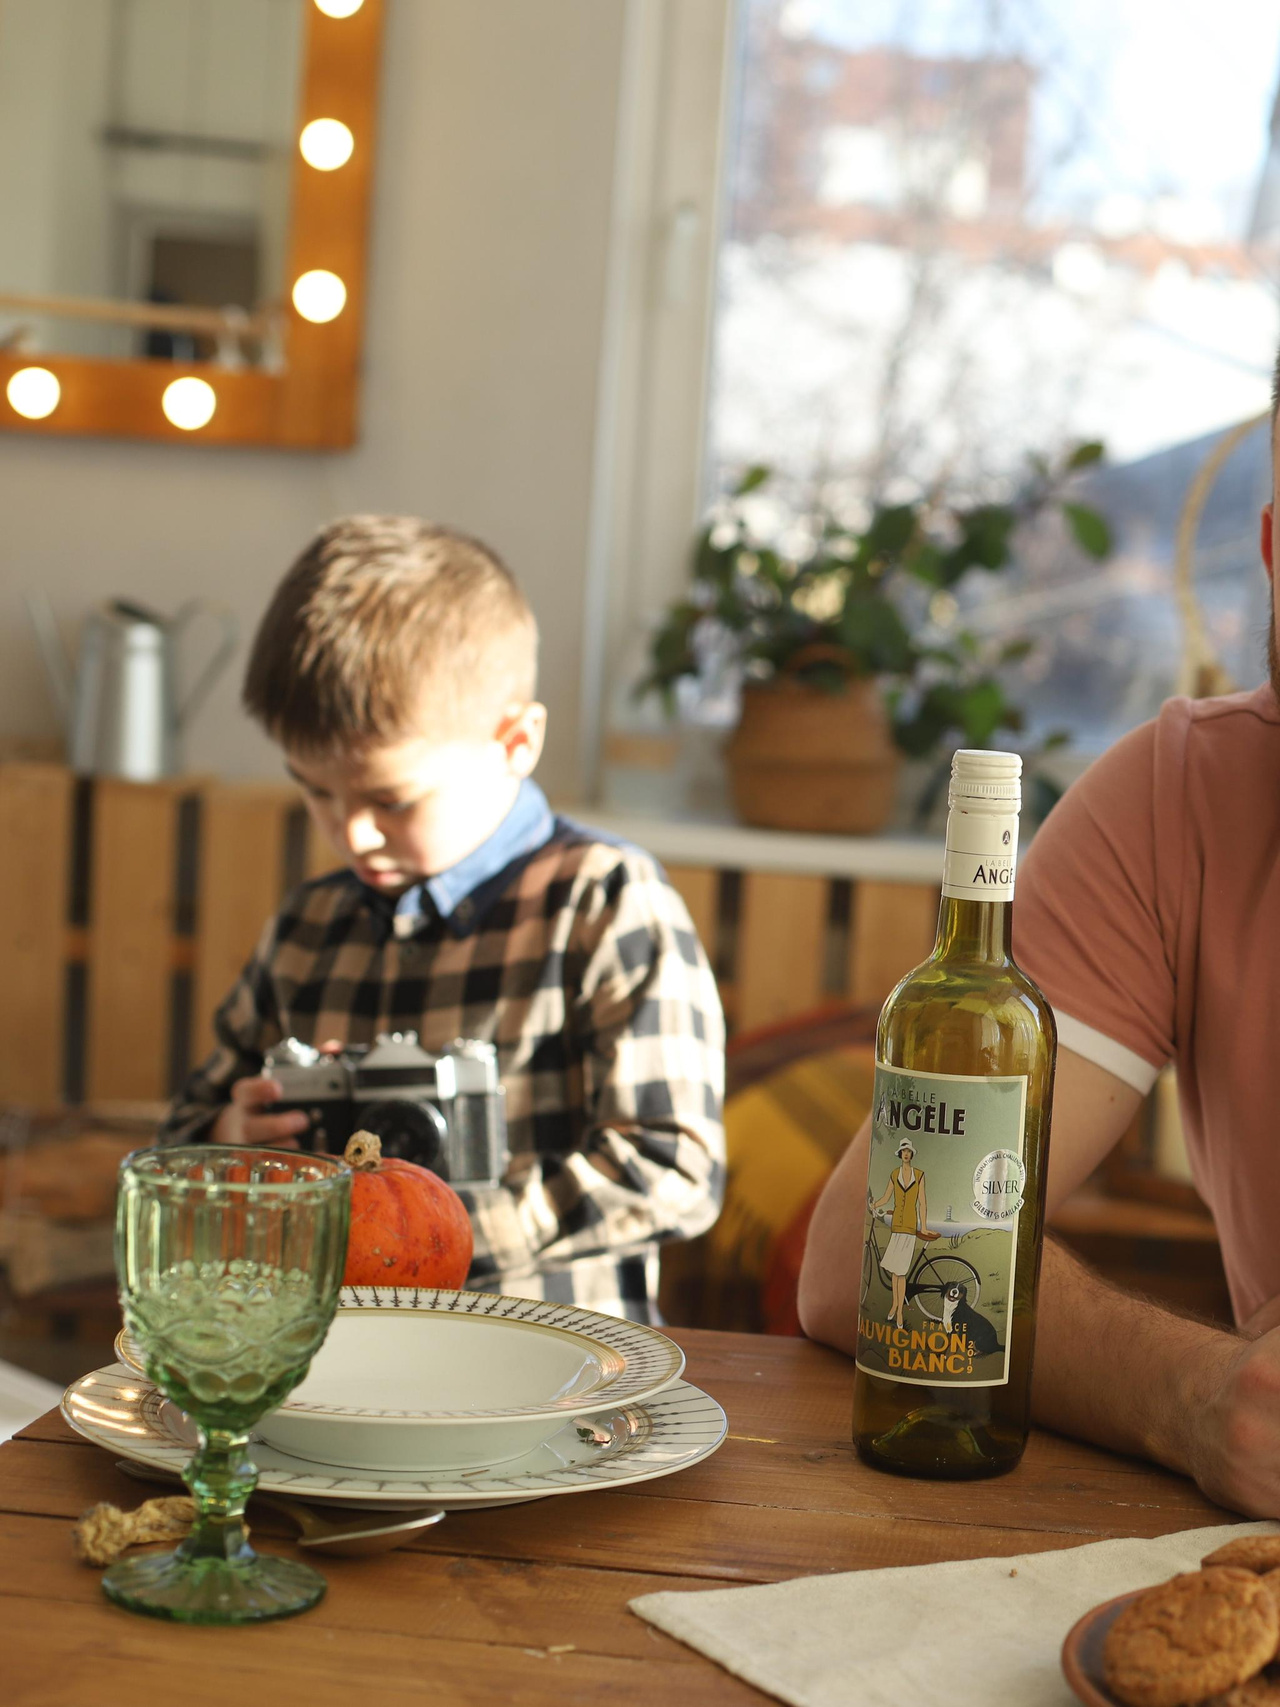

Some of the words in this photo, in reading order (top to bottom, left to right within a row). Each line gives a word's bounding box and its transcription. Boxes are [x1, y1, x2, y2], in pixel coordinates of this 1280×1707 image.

[997, 859, 1012, 867] BEL
[901, 1089, 936, 1104] BELLE
[975, 1153, 1002, 1183] INTERNATIONAL
[981, 1180, 1019, 1195] SILVER
[973, 1200, 994, 1218] GILBERT
[1000, 1199, 1023, 1219] GAILLARD
[859, 1316, 967, 1353] AUVIGNON
[888, 1347, 965, 1374] BLANC
[966, 1340, 974, 1374] 2019
